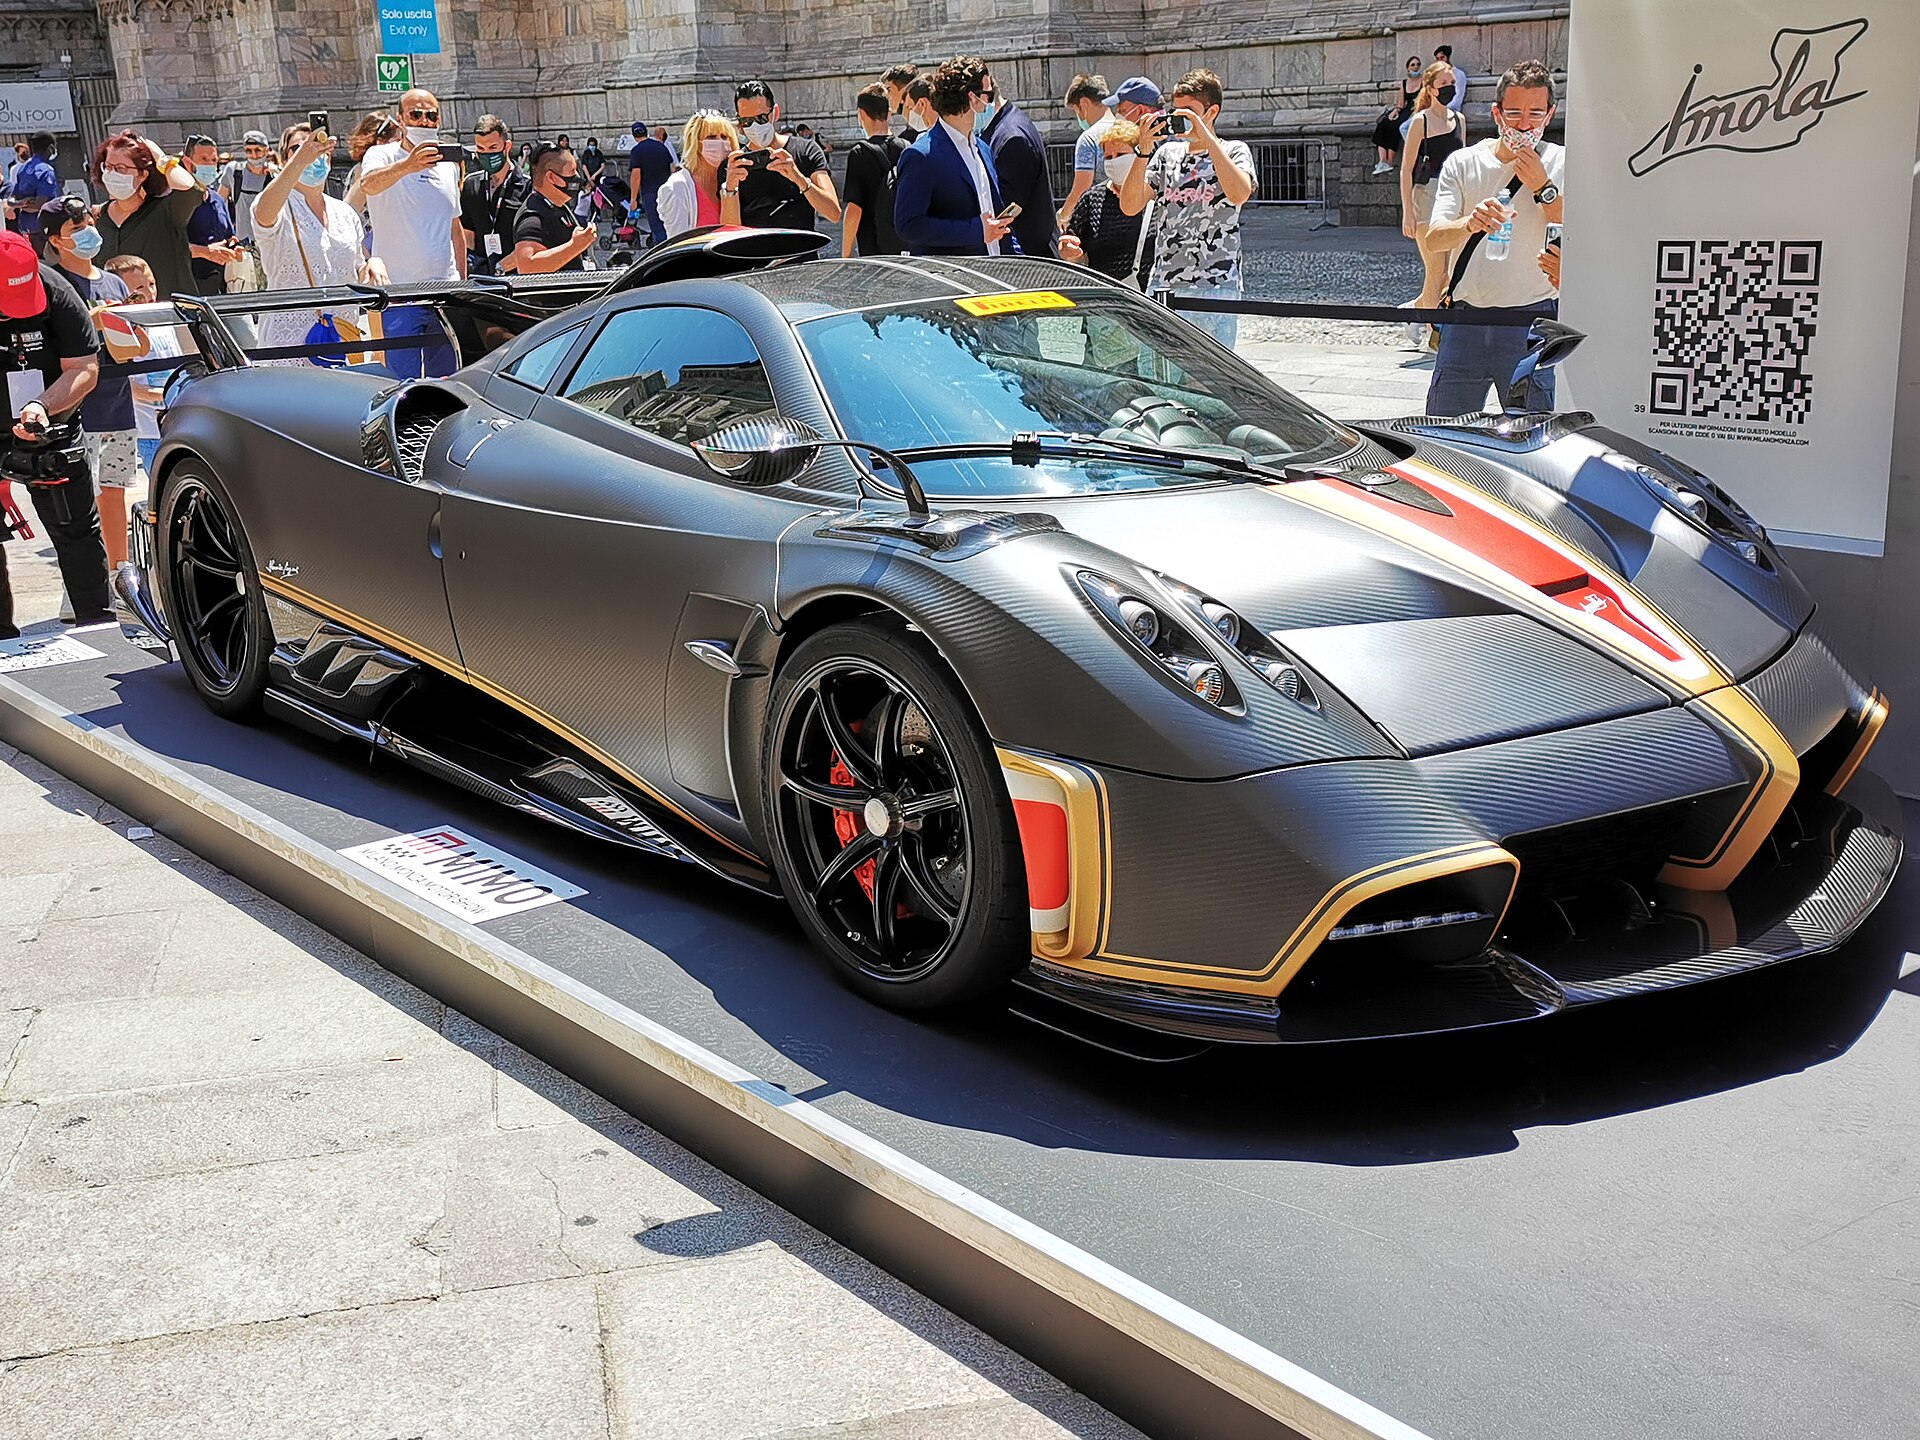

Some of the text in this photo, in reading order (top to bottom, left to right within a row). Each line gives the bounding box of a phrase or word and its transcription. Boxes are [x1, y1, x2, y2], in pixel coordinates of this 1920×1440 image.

[381, 9, 433, 19] Solo uscita
[389, 25, 428, 37] Exit only
[385, 83, 404, 91] DAE
[0, 108, 64, 123] ON FOOT
[1634, 404, 1646, 413] 39
[1671, 422, 1698, 430] ULTERIORI
[1698, 425, 1737, 433] INFORMAZIONI
[1770, 430, 1798, 438] MODELLO
[1648, 428, 1679, 436] SCANSIONA
[1695, 431, 1710, 439] CODE
[1736, 434, 1810, 446] WWW.MILANOMONZA.COM
[423, 850, 554, 905] MIMO
